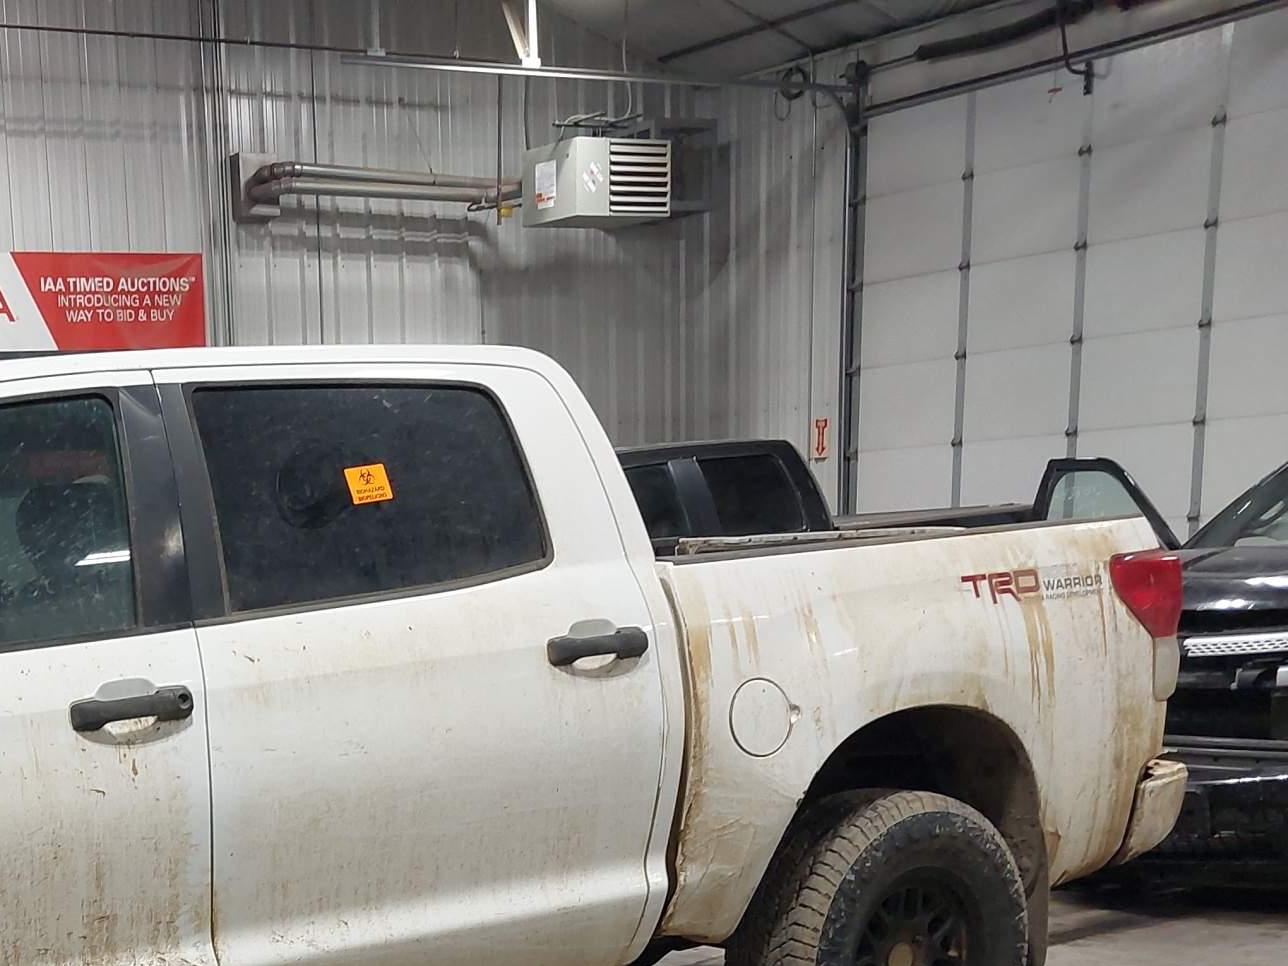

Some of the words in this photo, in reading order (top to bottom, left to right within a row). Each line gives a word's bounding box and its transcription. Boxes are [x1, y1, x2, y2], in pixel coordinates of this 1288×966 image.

[40, 277, 65, 292] IAA
[66, 277, 113, 292] TIMED
[57, 294, 139, 307] INTRODUCING
[142, 294, 152, 307] A
[154, 294, 183, 307] NEW
[65, 309, 94, 322] WAY
[96, 309, 113, 322] TO
[116, 309, 135, 322] BID
[137, 309, 147, 322] &
[150, 309, 175, 321] BUY
[960, 569, 1040, 604] TRD
[1043, 574, 1103, 591] WARRIOR
